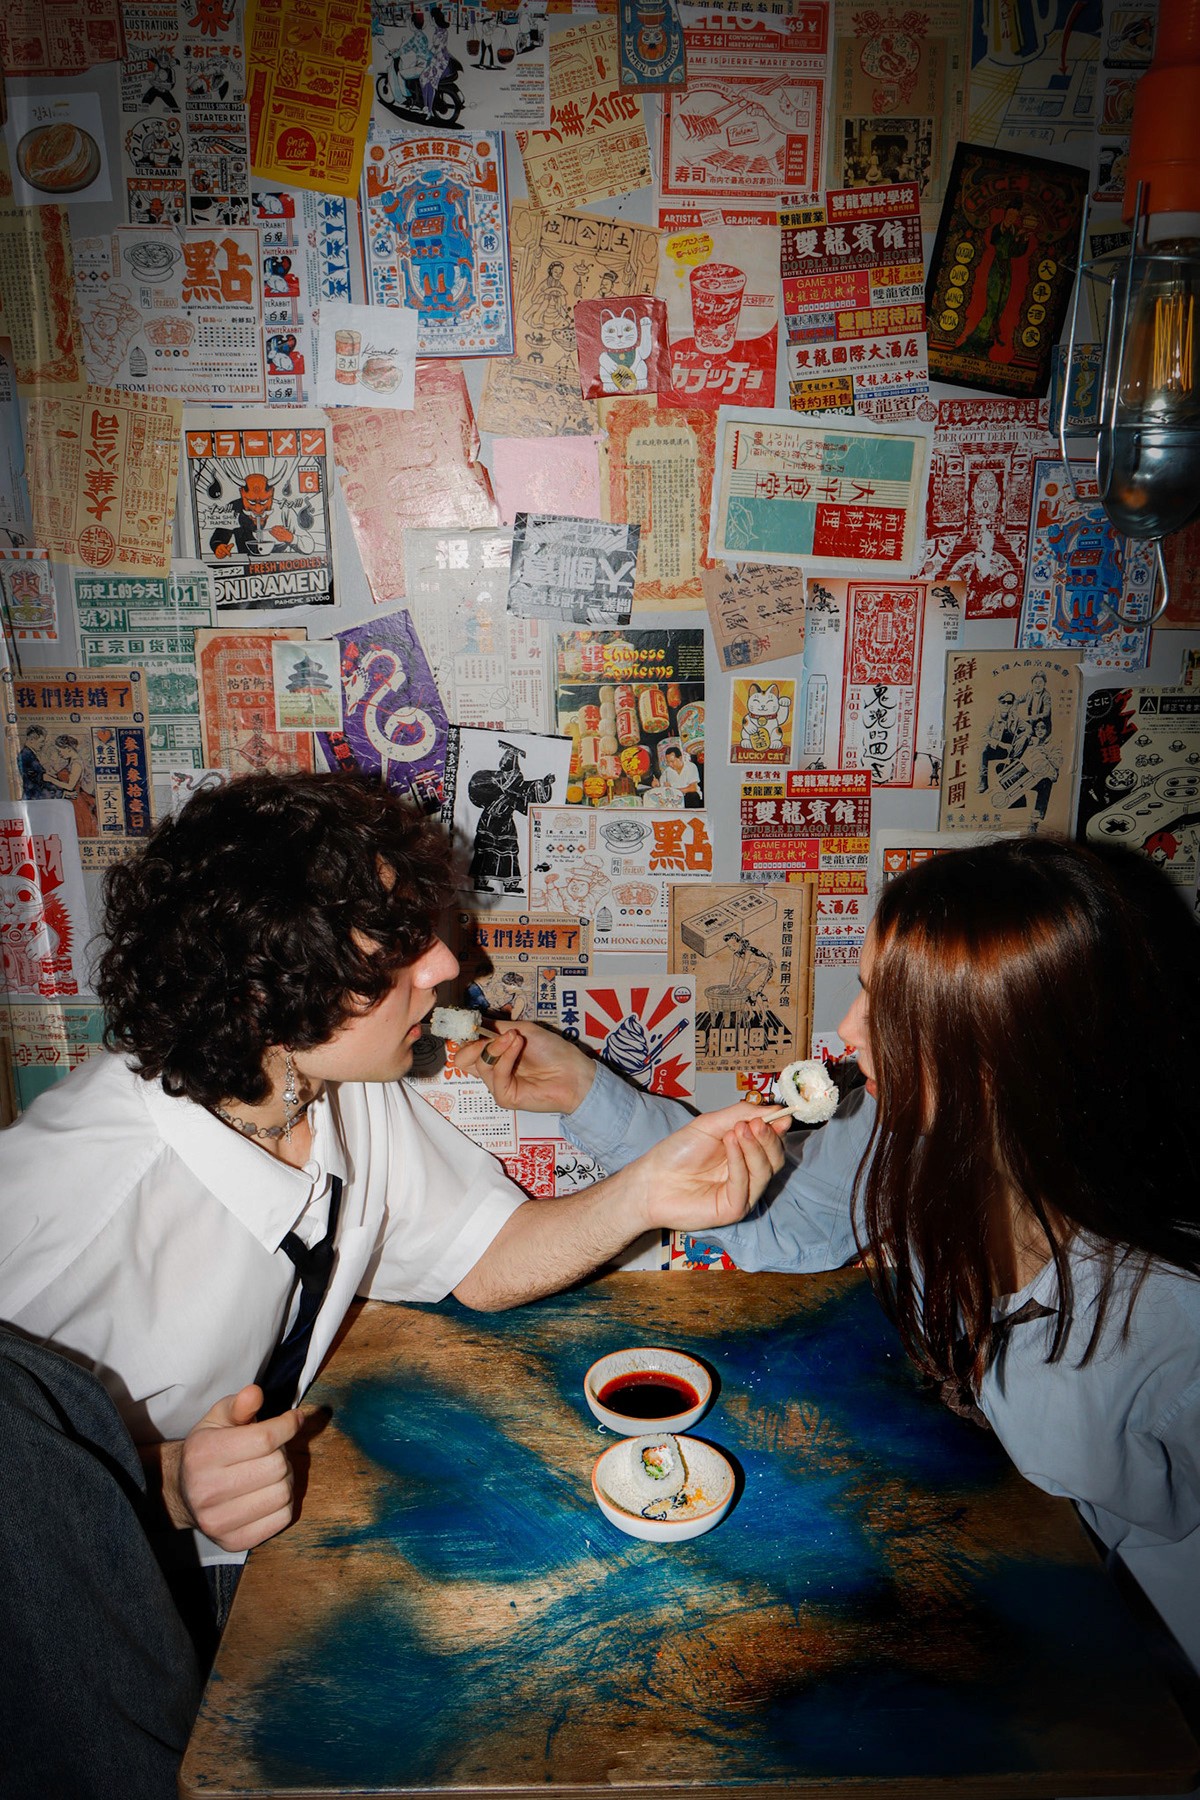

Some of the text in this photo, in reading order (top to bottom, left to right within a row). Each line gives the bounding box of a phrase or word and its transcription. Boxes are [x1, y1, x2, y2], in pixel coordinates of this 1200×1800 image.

[626, 40, 679, 72] RAMEN TEMPLE
[790, 59, 824, 68] POSTEL
[122, 61, 149, 74] RIDER
[194, 114, 228, 122] STARTER
[136, 169, 178, 177] ULTRAMAN
[675, 166, 706, 183] 寿司
[664, 214, 692, 223] ARTIST
[726, 216, 762, 225] GRAPHIC
[793, 220, 907, 259] 雙龍賓館
[783, 248, 922, 272] DOUBLE DRAGON HOTEL
[182, 238, 254, 305] 點
[783, 270, 803, 278] HOTEL
[841, 264, 857, 272] OVER
[858, 262, 879, 270] NIGHT
[797, 274, 856, 289] GAME FUN
[873, 284, 925, 300] 雙龍賓館
[838, 306, 923, 331] 雙龍招待所
[862, 328, 885, 336] DRAGON
[674, 351, 699, 361] ロッテ
[796, 338, 919, 369] 雙龍國際大酒店
[850, 362, 896, 371] INTERNATIONAL
[672, 360, 764, 395] カプッチョ
[856, 370, 928, 388] 雙龍洗浴中心
[116, 384, 261, 394] FROM HONG KONG TO TAIPEI
[792, 393, 852, 410] 特約租售
[220, 434, 322, 455] ラーメン
[938, 430, 1042, 443] DER GOTT DER HUNDE
[83, 410, 120, 522] 大華公司
[305, 476, 314, 490] 6
[822, 508, 900, 534] 和洋料理
[858, 538, 896, 557] 喫茶
[249, 558, 321, 574] FRESH NOODLES
[80, 583, 165, 600] 历史上的今天!
[171, 585, 195, 602] 01
[215, 570, 327, 601] ONI RAMEN
[80, 609, 124, 628] 號外!
[88, 640, 166, 654] 正宗国货
[602, 643, 666, 664] Chinese
[603, 662, 675, 681] Lanterns
[16, 686, 130, 709] 我們结婚了
[851, 693, 860, 701] 11
[905, 689, 915, 706] The
[849, 703, 860, 711] 01
[948, 657, 977, 807] 鮮花在岸上開
[739, 752, 785, 761] LUCKY CAT
[846, 751, 857, 759] 01
[845, 761, 858, 769] 25
[900, 752, 912, 780] Ghosts
[792, 774, 867, 788] 雙龍駕駛學校
[743, 786, 783, 797] 雙龍置業
[103, 790, 119, 825] 天生一对
[754, 800, 857, 826] 雙龍賓館
[743, 824, 869, 835] DOUBLE DRAGON HOTEL
[649, 817, 713, 873] 點
[753, 841, 807, 849] GAME FUN
[822, 854, 869, 865] 雙龍賓館
[817, 899, 859, 915] 大酒店
[478, 928, 578, 949] 我們结婚了
[594, 937, 609, 945] OM
[640, 938, 667, 946] KONG
[561, 990, 580, 1042] 日本の
[558, 1142, 575, 1150] The
